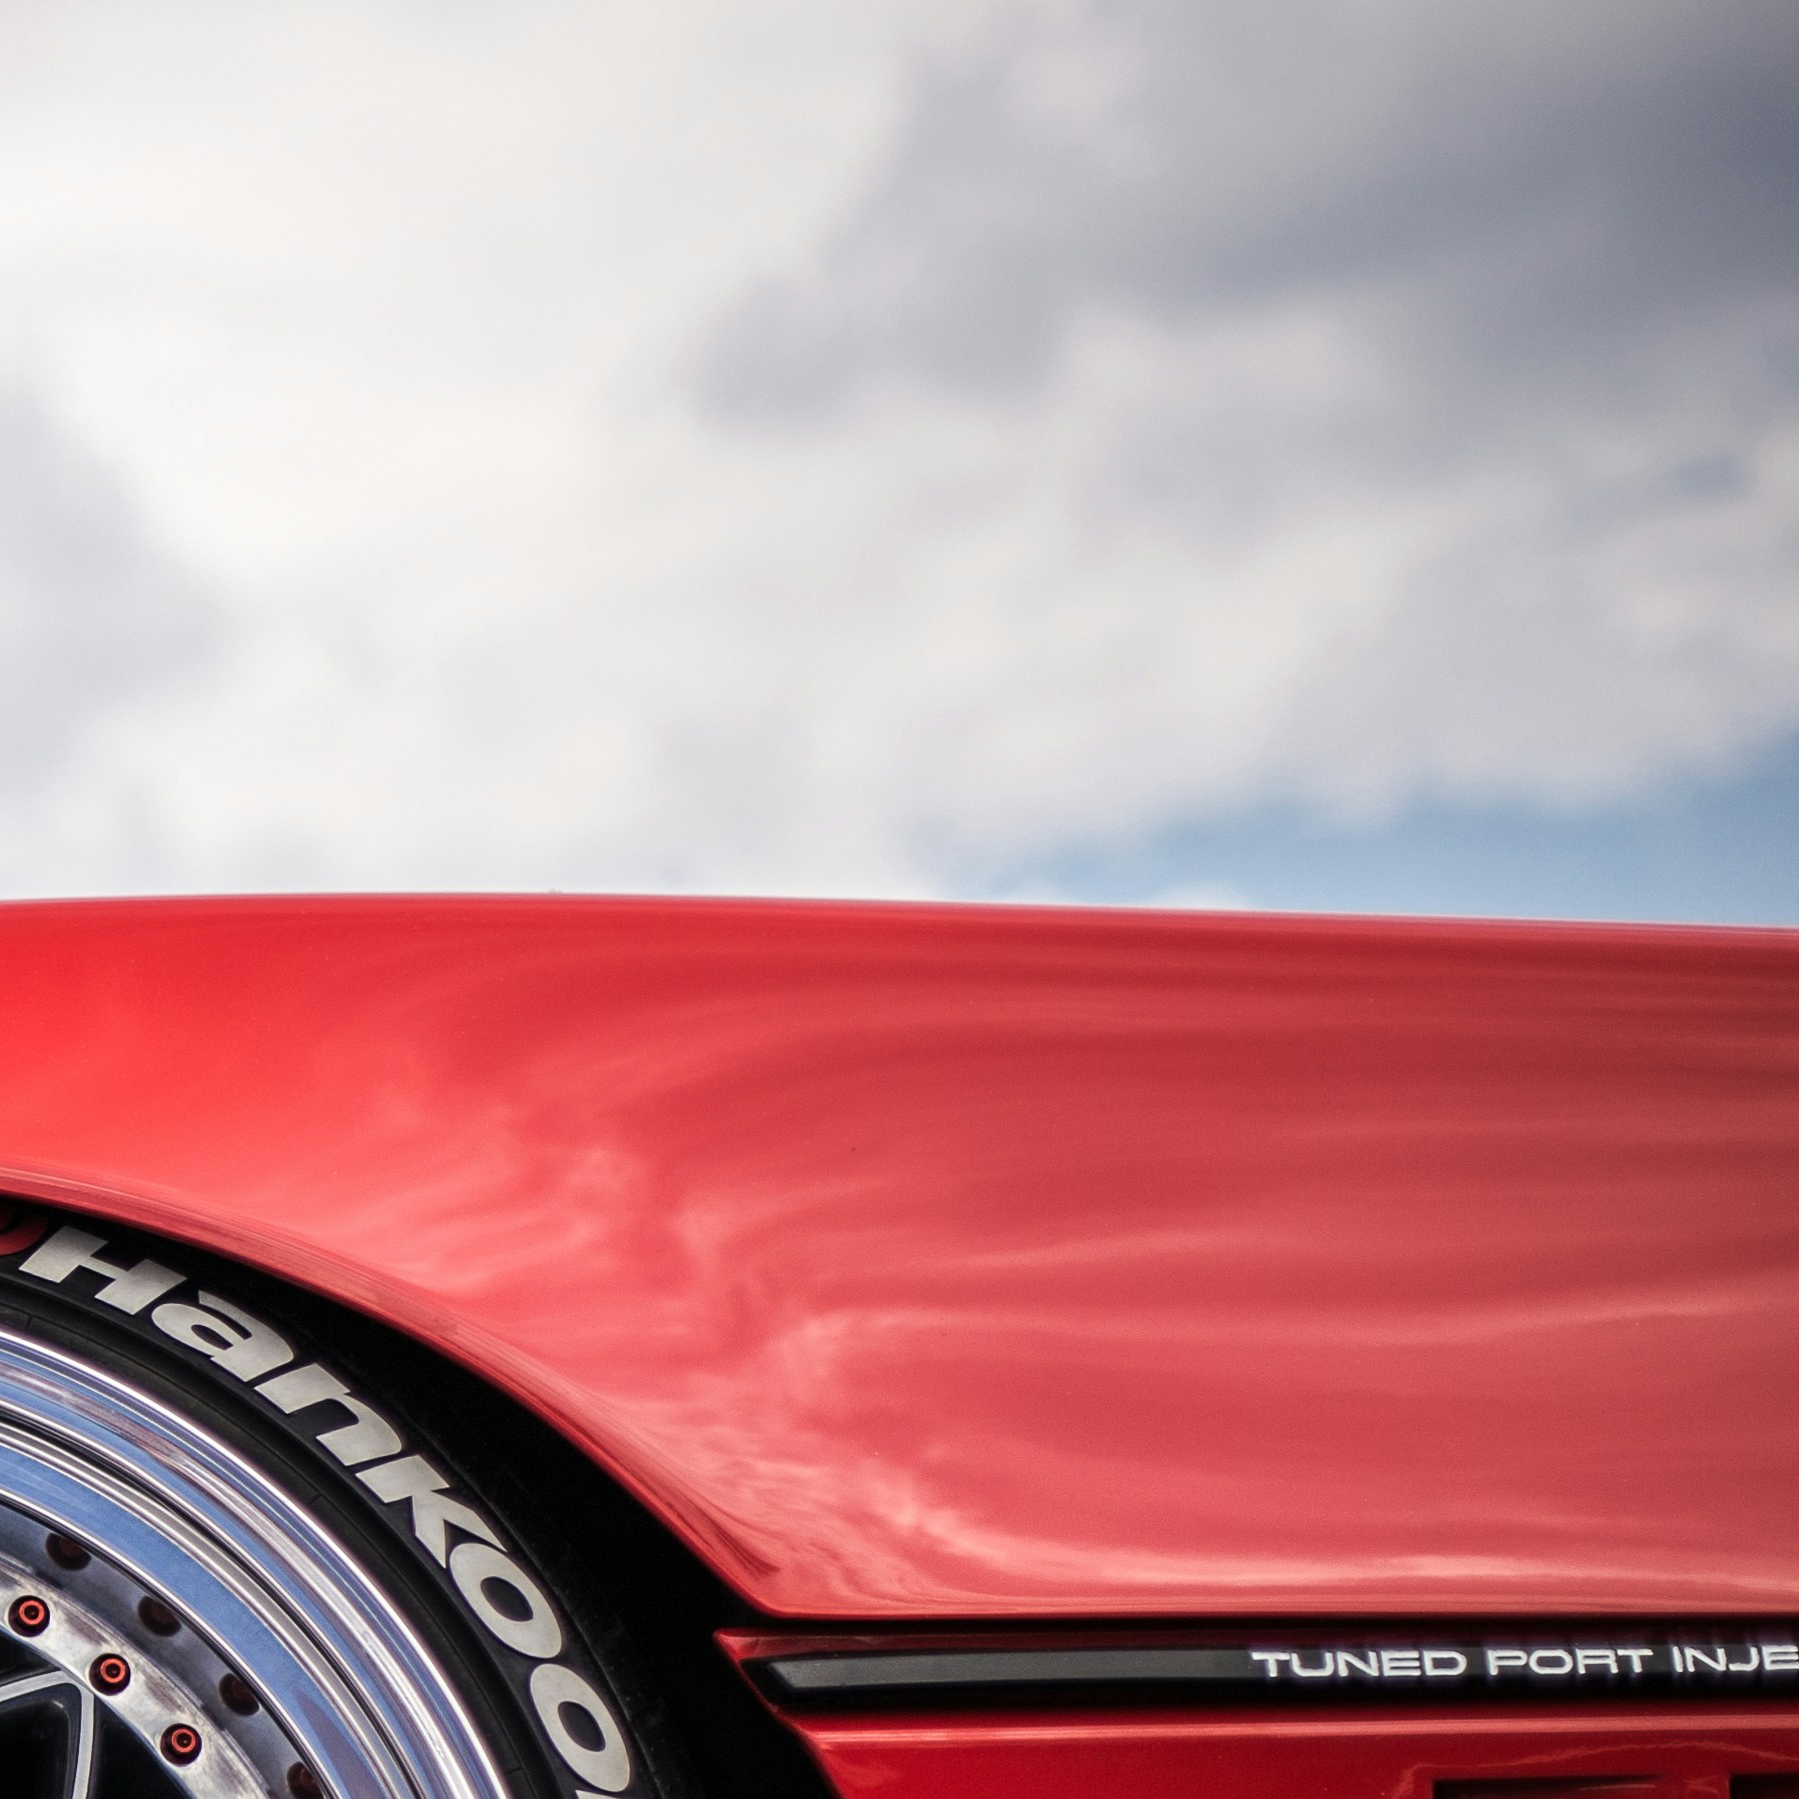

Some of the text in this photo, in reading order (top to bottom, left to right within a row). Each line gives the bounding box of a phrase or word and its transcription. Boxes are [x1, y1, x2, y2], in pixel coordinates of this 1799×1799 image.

[1251, 1645, 1799, 1678] TUNED PORT INJE
